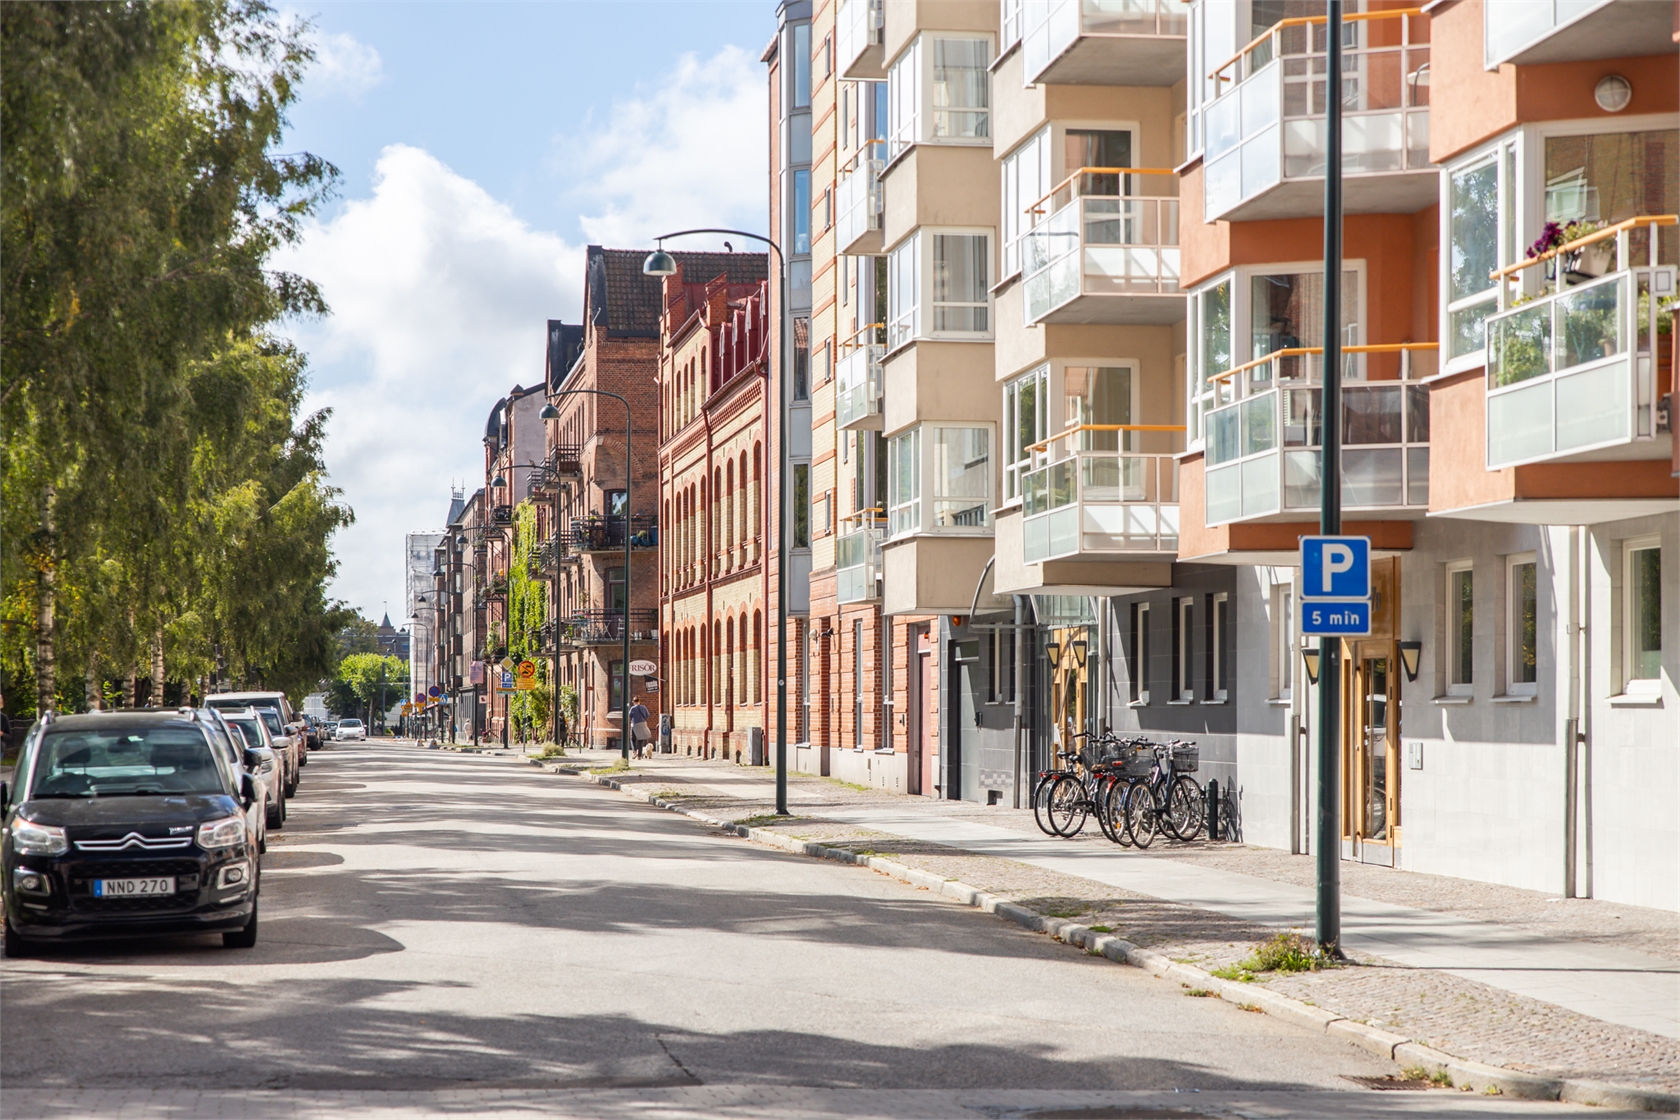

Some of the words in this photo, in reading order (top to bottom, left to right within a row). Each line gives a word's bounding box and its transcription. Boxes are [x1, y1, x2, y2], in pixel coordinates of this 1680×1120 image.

[1322, 543, 1354, 592] P
[1312, 611, 1322, 625] 5
[1330, 611, 1360, 625] min
[504, 673, 511, 682] P
[107, 881, 134, 893] NND
[140, 879, 168, 893] 270
